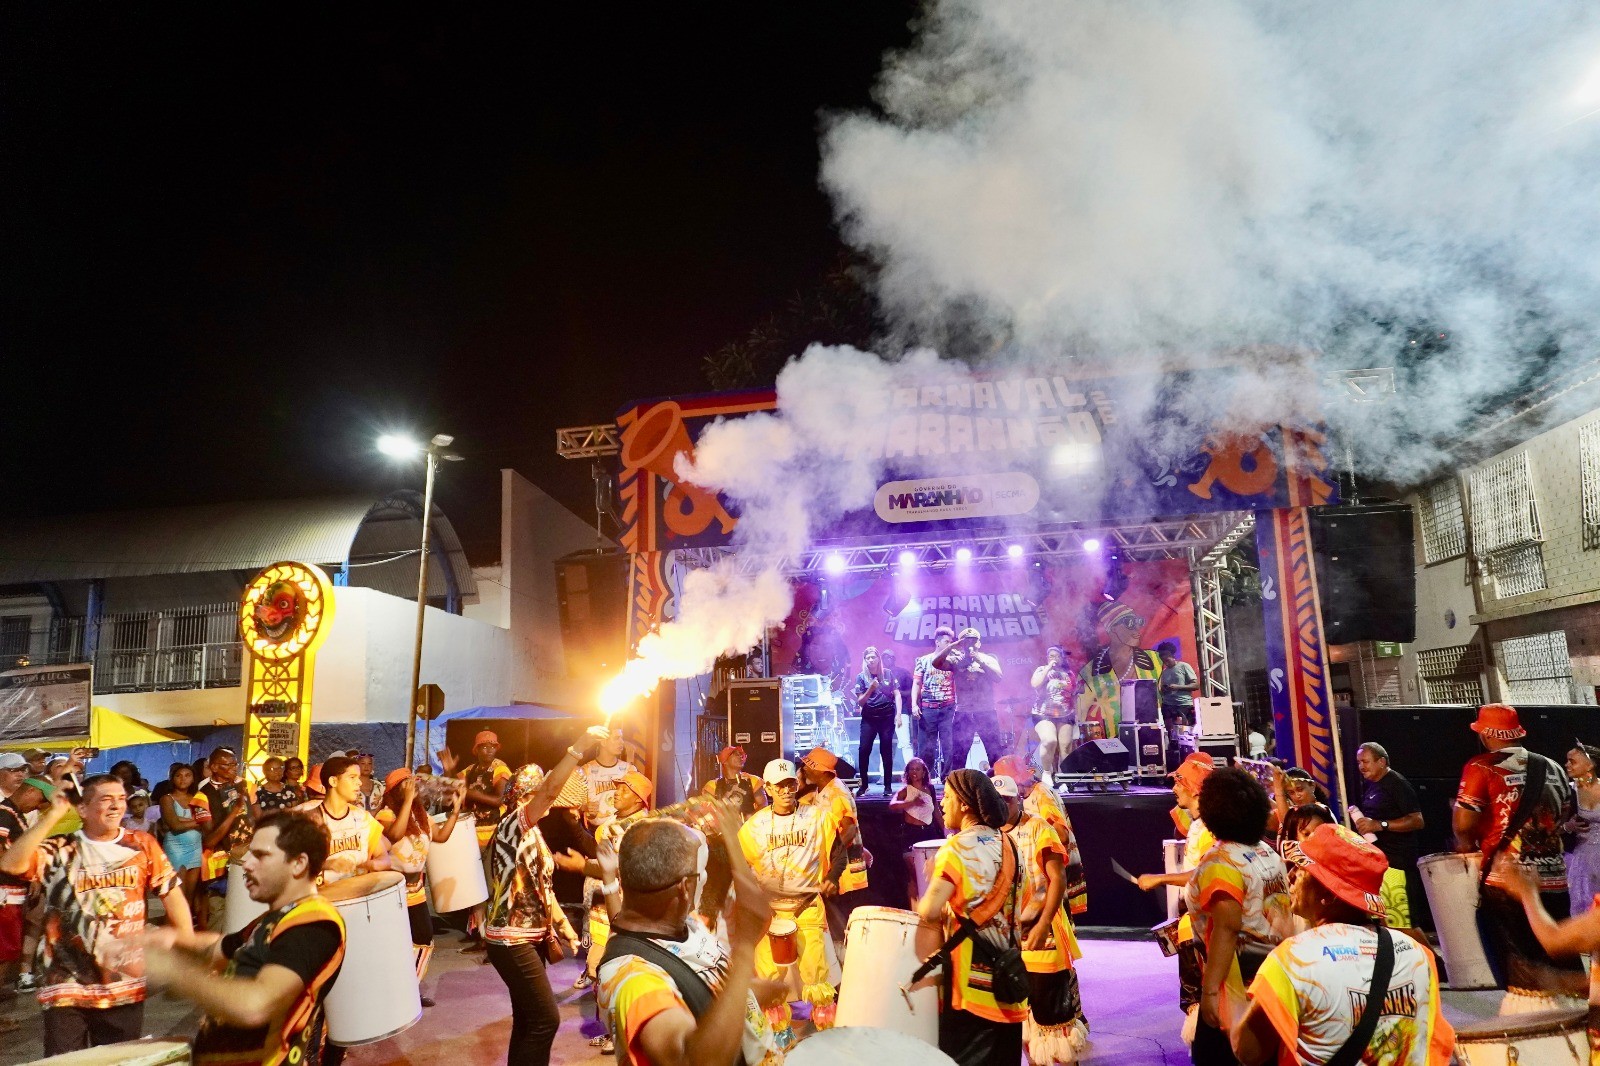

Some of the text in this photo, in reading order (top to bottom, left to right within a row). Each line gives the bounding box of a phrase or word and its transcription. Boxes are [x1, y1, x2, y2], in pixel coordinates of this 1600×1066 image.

[866, 376, 1087, 410] ARNAVAL
[888, 486, 1026, 510] MARANHÃO SECMA
[912, 593, 1033, 614] ARNAVAL
[1006, 657, 1033, 667] SECMA
